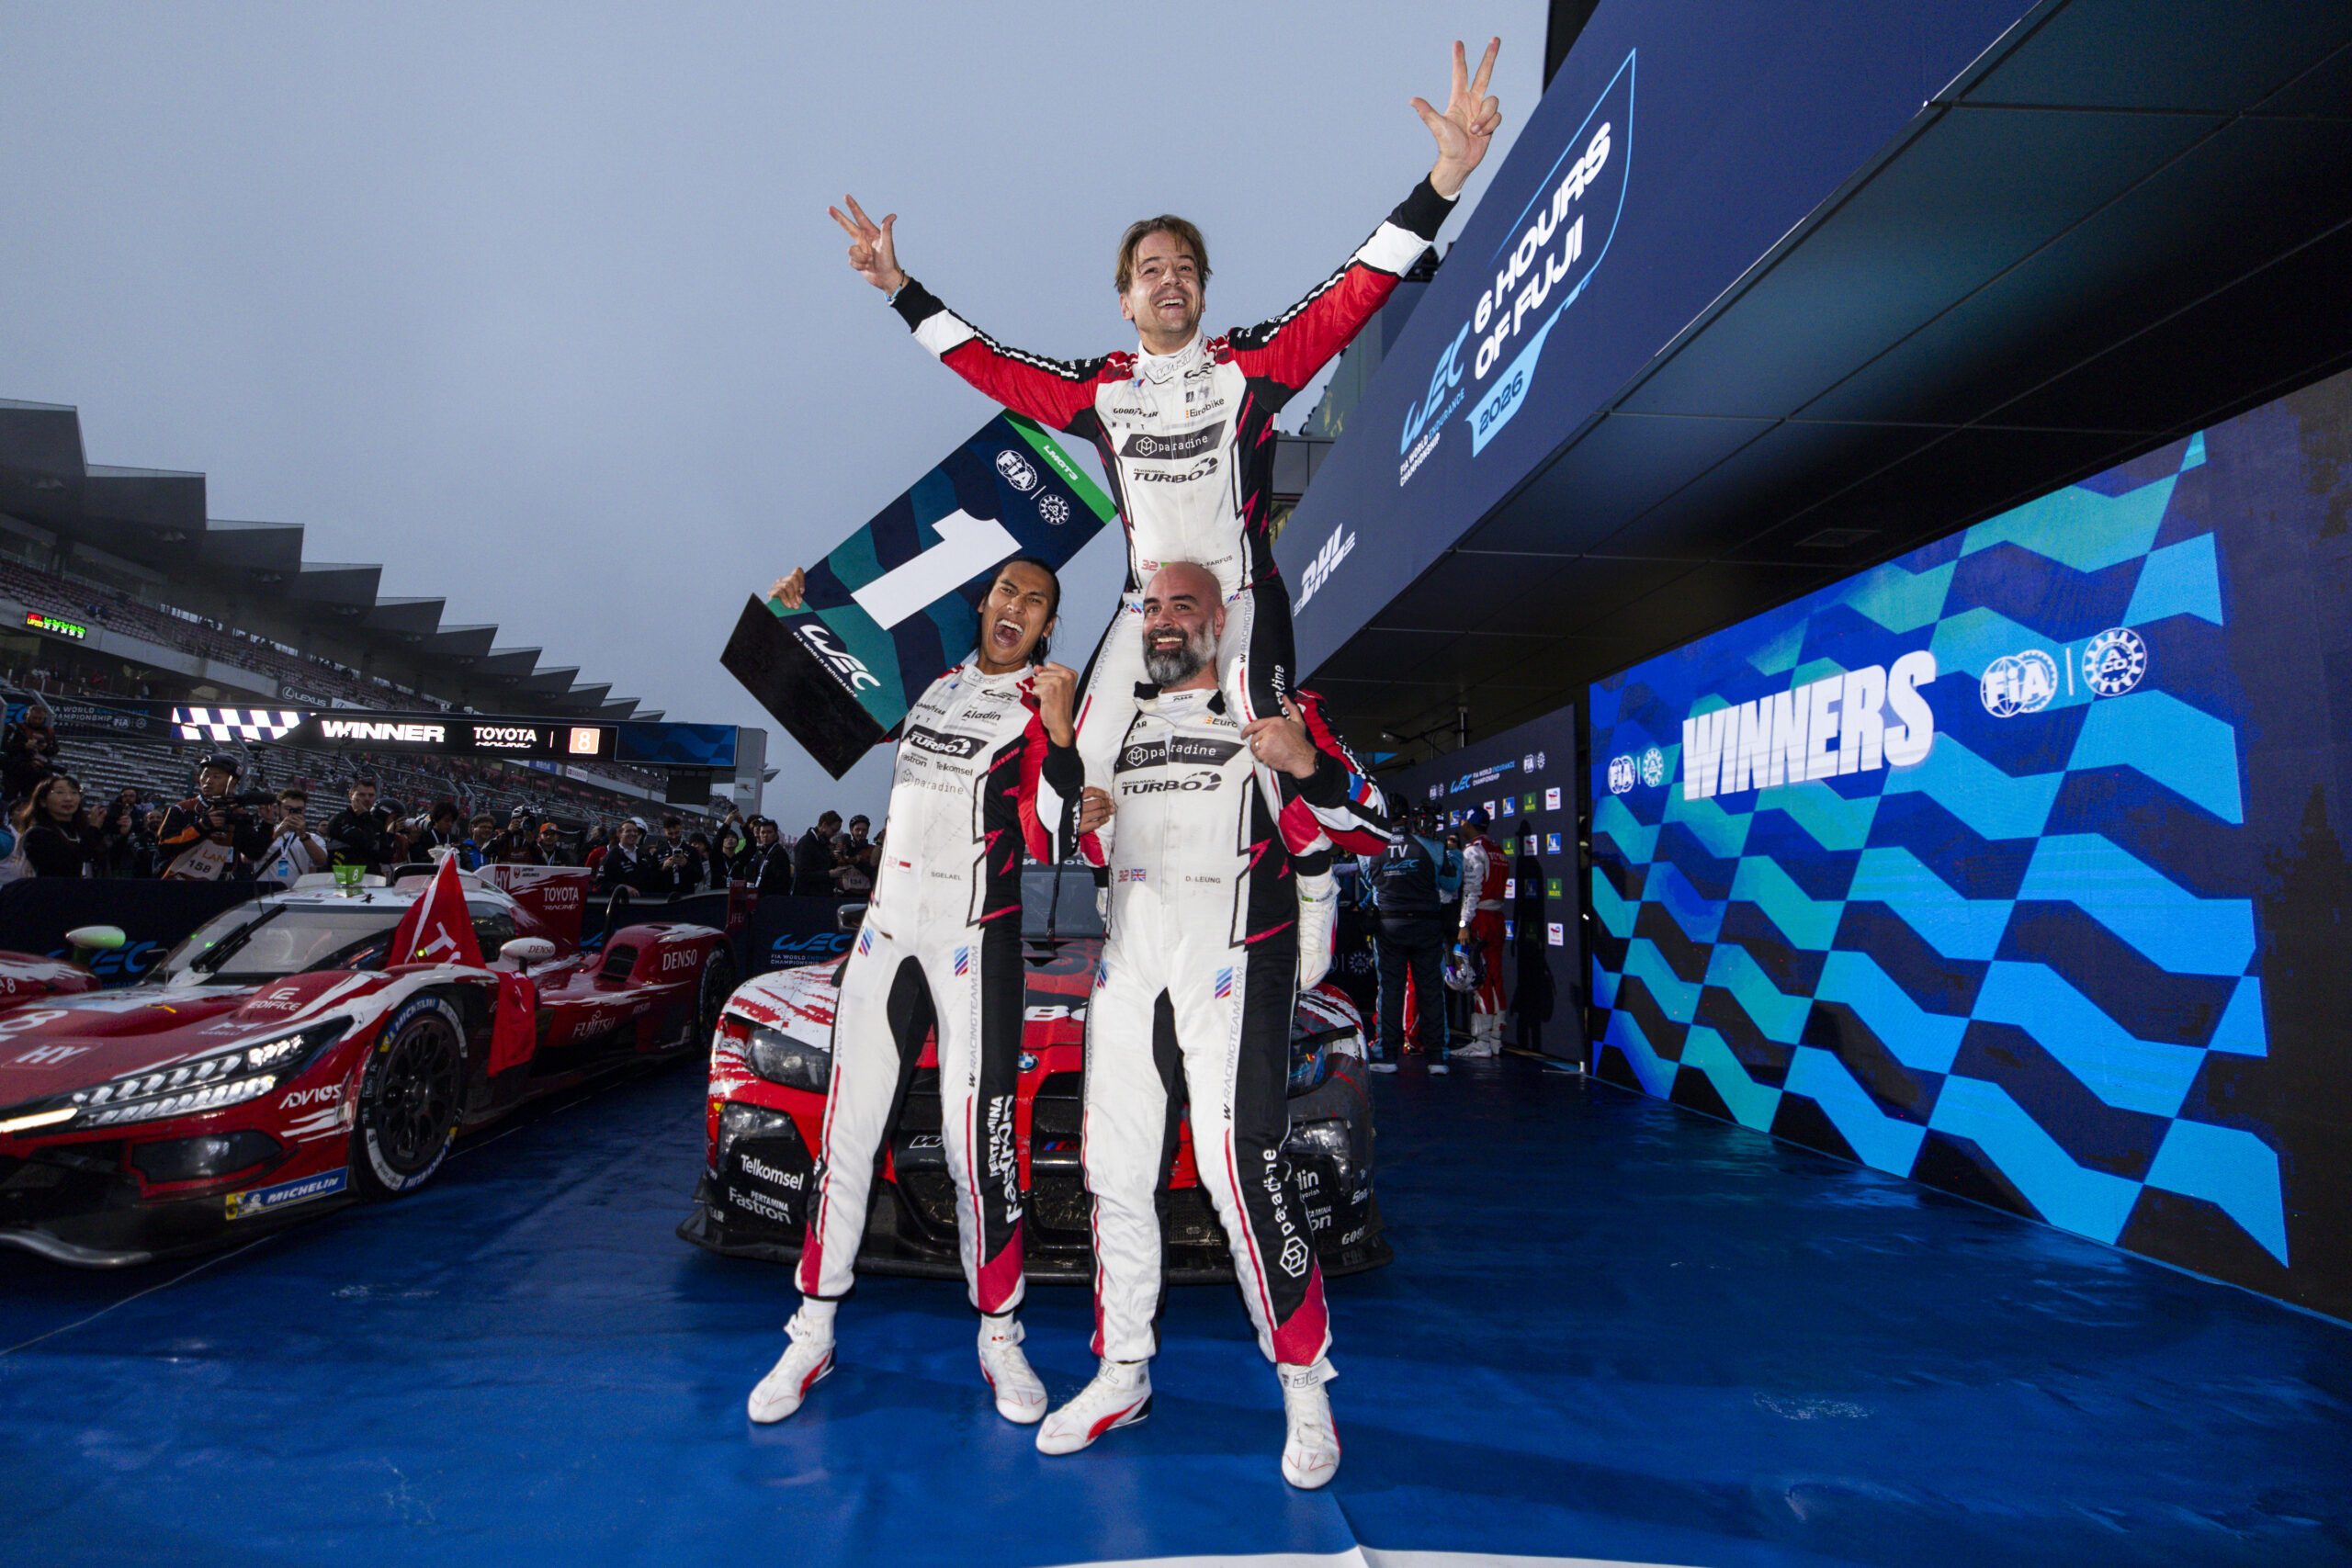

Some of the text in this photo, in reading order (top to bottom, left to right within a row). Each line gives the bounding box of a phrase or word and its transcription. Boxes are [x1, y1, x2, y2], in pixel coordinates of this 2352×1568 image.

[1474, 121, 1611, 334] 6 HOURS
[1475, 214, 1584, 381] OF FUJI
[1400, 320, 1471, 456] WEC
[1190, 398, 1225, 418] Eurobike
[1478, 370, 1524, 436] 2026
[1399, 387, 1466, 476] FIA WORLD ENDURANCE
[1158, 435, 1209, 453] paradine
[1043, 445, 1080, 481] LMGT3
[1399, 432, 1441, 488] CHAMPIONSHIP
[1133, 469, 1204, 484] TURBO
[850, 507, 1023, 632] 1
[1141, 558, 1159, 572] 32
[1207, 554, 1234, 567] FARFUS
[1295, 523, 1355, 615] DHL
[799, 624, 882, 691] WEC
[1983, 658, 2053, 711] FIA
[63, 705, 95, 715] WORLD
[294, 692, 327, 708] LEXUS
[55, 713, 112, 722] AMPIONSHIP
[962, 709, 1002, 722] Aladin
[1682, 649, 1937, 801] WINNERS
[322, 720, 447, 743] WINNER
[473, 727, 537, 742] TOYOTA
[577, 730, 592, 751] 8
[910, 734, 958, 753] TURBO
[1150, 743, 1216, 760] paradine
[936, 761, 974, 777] Telkomsel
[914, 777, 964, 795] paradine
[1121, 780, 1203, 796] TURBO
[1387, 844, 1408, 859] TV
[189, 859, 212, 874] 158
[352, 867, 359, 882] 8
[496, 870, 510, 890] HY
[1194, 875, 1221, 885] LEUNG
[543, 886, 580, 902] TOYOTA
[528, 944, 555, 954] DENSO
[772, 932, 853, 953] WEC
[662, 948, 698, 971] DENSO
[7, 977, 17, 994] 8
[247, 1000, 302, 1011] EDIFICE
[0, 1010, 69, 1032] 8
[572, 1017, 616, 1038] FUJITSU
[1223, 965, 1244, 1121] W-RACINGTEAM.COM
[16, 1045, 91, 1065] HY
[741, 1154, 805, 1191] Telkomsel
[266, 1177, 339, 1204] MICHELIN
[729, 1186, 792, 1225] Fastron
[751, 1190, 789, 1213] PERTAMINA
